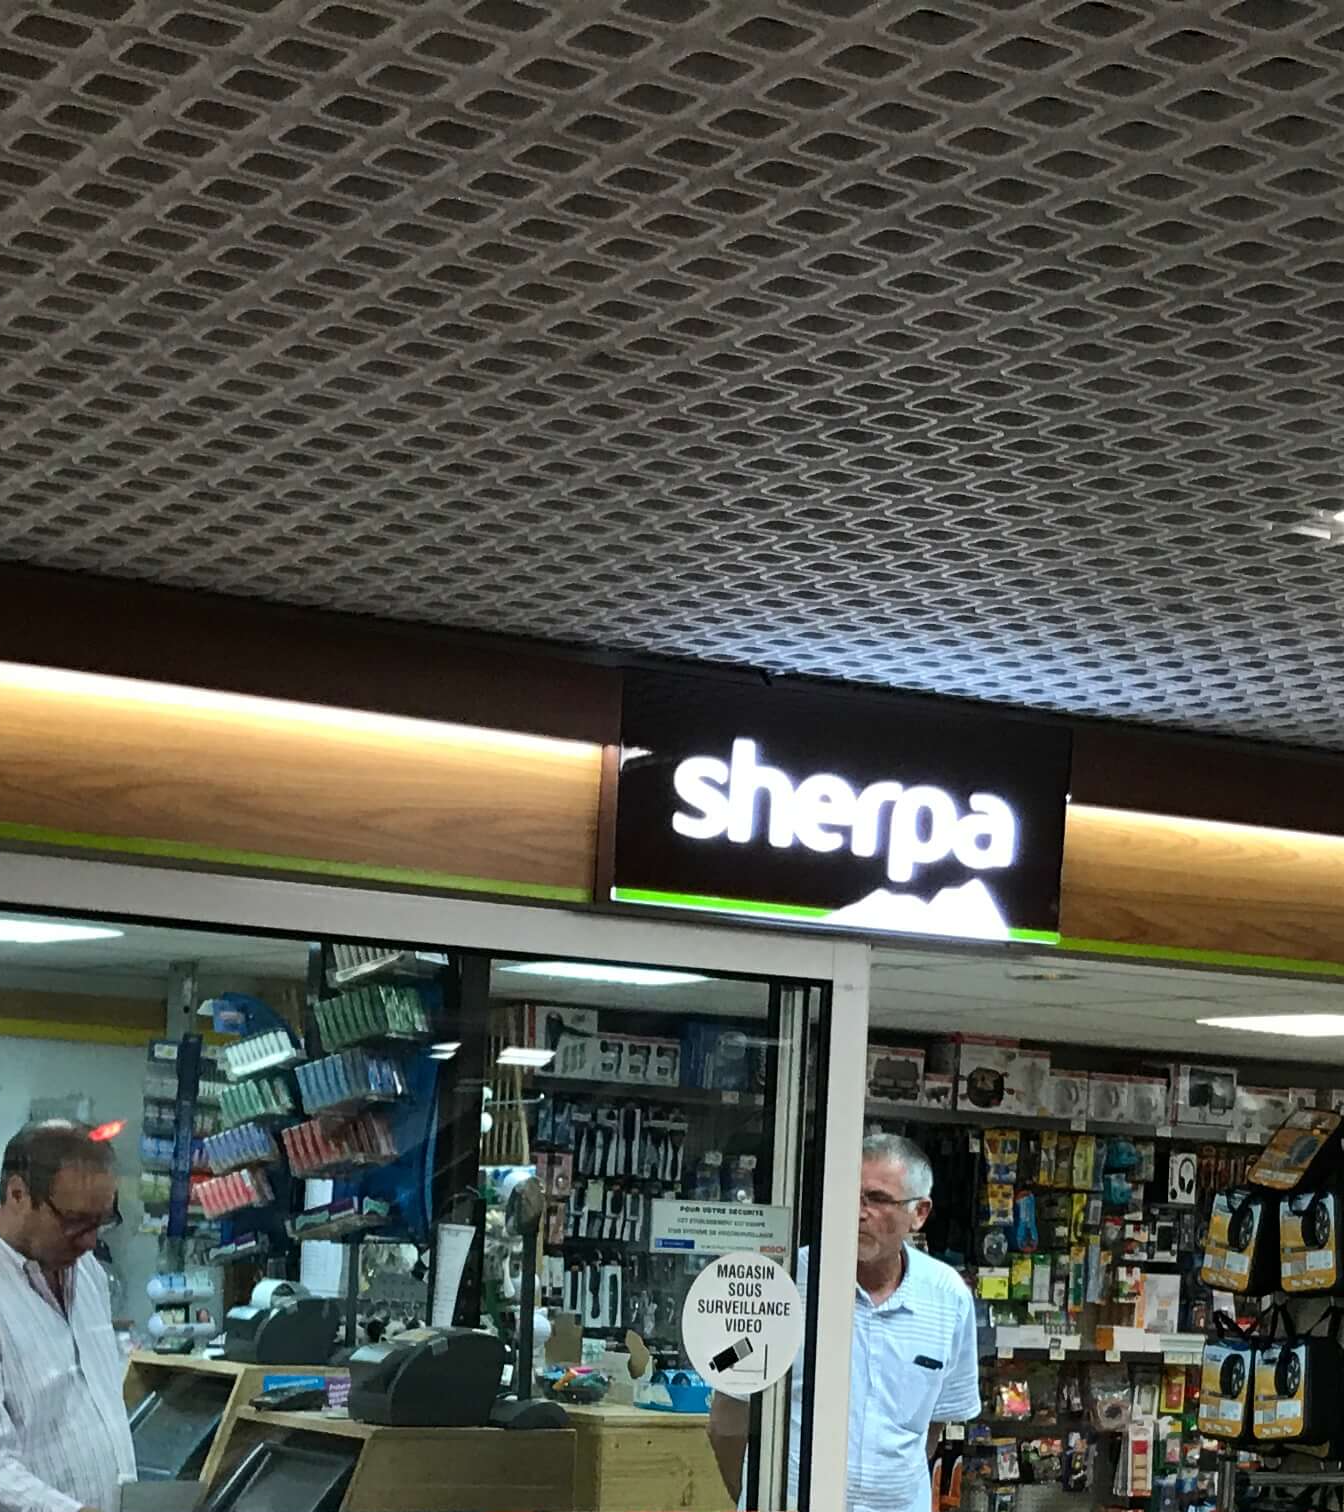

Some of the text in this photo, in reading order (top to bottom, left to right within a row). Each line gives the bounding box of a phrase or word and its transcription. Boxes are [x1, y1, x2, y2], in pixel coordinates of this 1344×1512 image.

[672, 738, 1018, 882] sherpa
[717, 1264, 775, 1281] MAGASIN
[728, 1282, 762, 1298] SOUS
[697, 1299, 791, 1317] SURVEILLANCE
[725, 1318, 762, 1334] VIDEO
